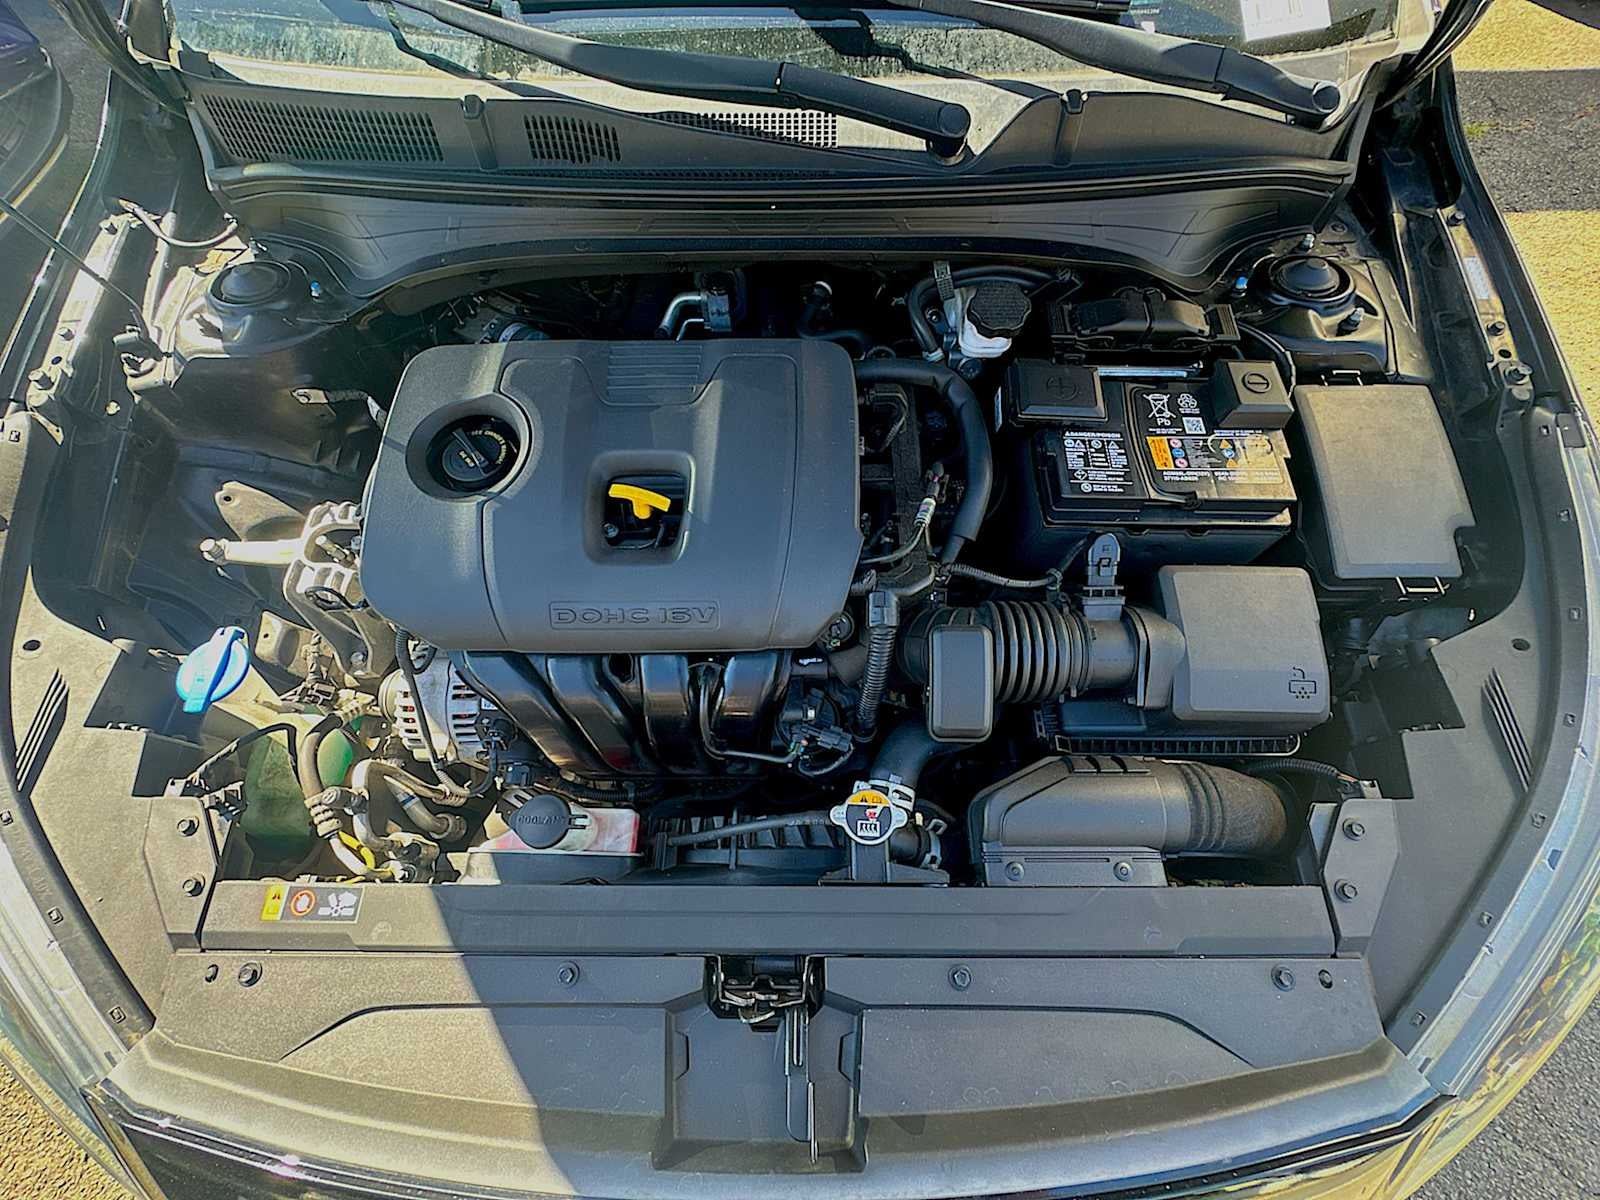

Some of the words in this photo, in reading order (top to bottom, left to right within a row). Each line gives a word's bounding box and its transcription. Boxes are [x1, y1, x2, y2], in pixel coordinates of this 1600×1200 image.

[1156, 417, 1171, 426] Pb
[552, 607, 650, 624] DOHC
[658, 607, 717, 624] 16V
